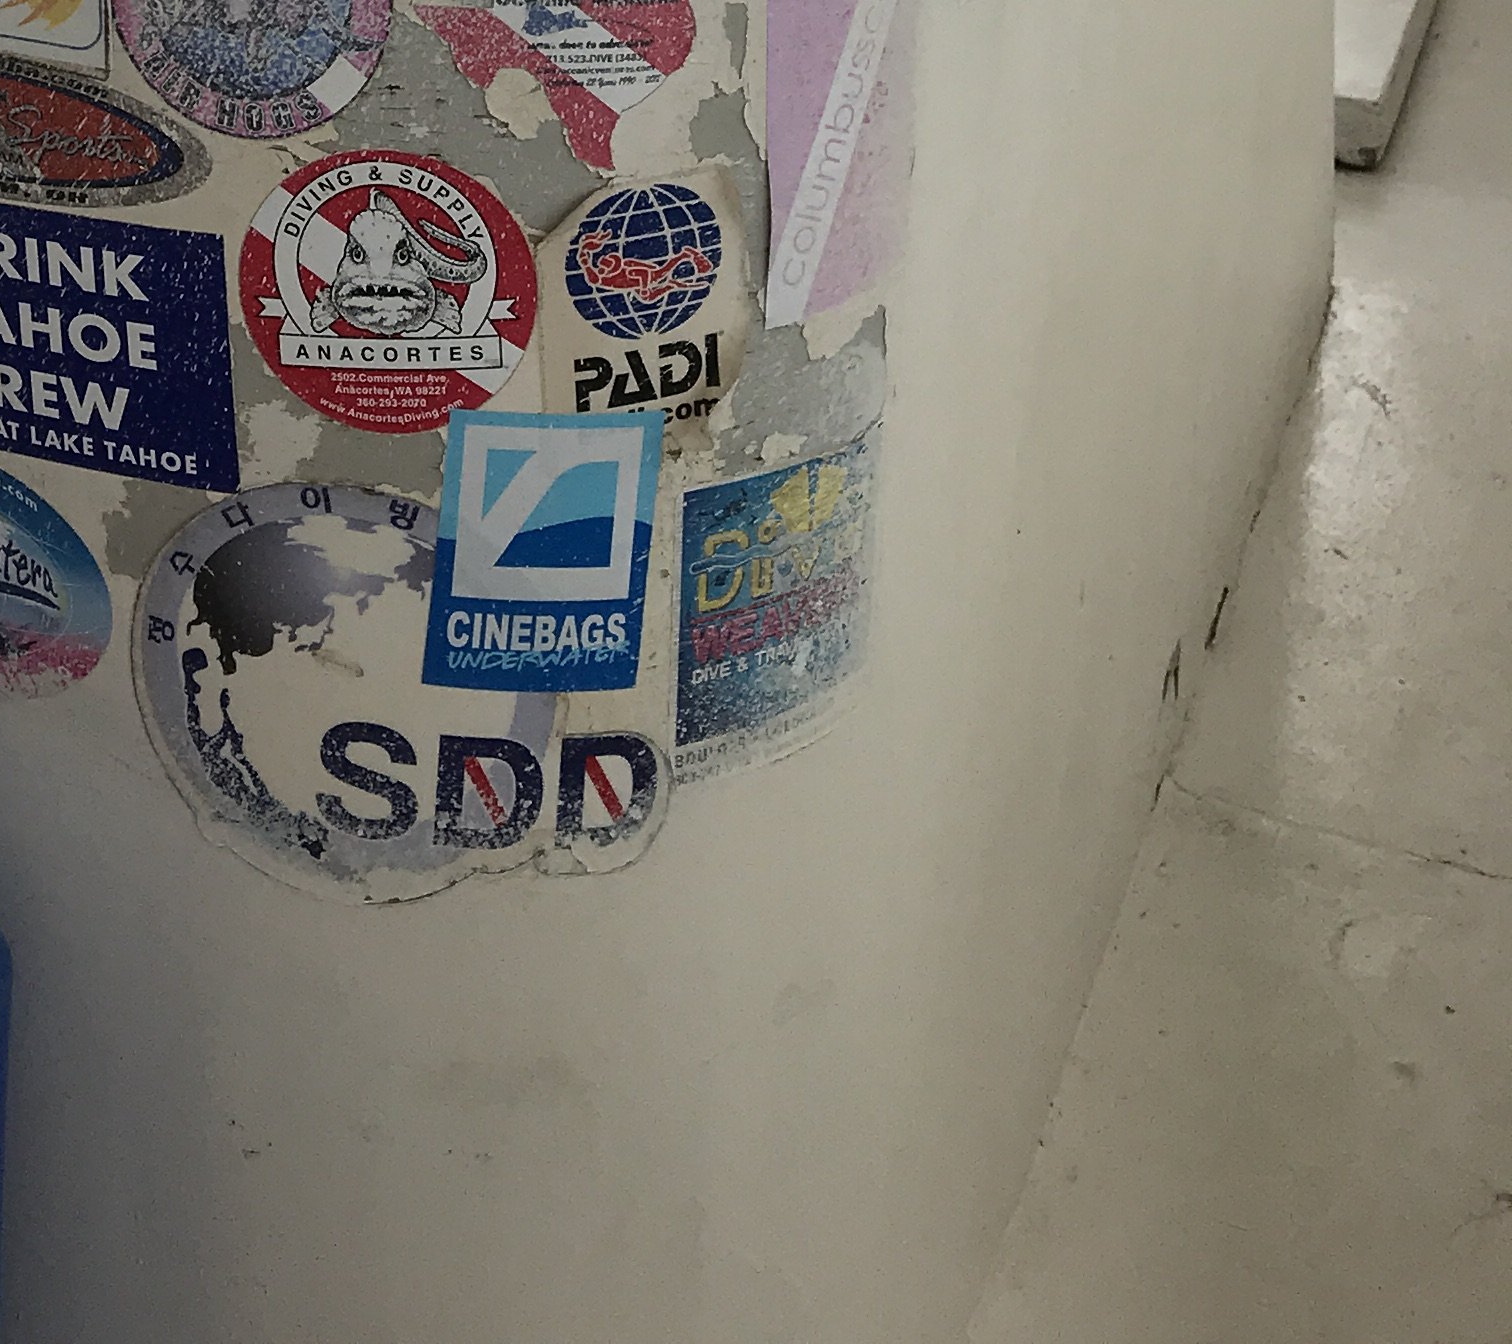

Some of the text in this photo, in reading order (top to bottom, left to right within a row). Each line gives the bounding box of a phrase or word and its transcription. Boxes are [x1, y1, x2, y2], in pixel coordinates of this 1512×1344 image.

[283, 164, 485, 241] DIVING & SUPPLY
[295, 343, 485, 363] ANACORTES
[330, 372, 424, 384] 2502 Commercial
[394, 385, 413, 395] WA
[573, 332, 722, 414] PADI
[319, 397, 465, 424] www.AnacortesDiving.com
[30, 425, 95, 458] LAKE
[103, 441, 199, 477] TAHOE
[446, 610, 627, 653] CINEBAGS
[445, 639, 630, 672] UNDERWATER
[315, 719, 660, 850] SDD
